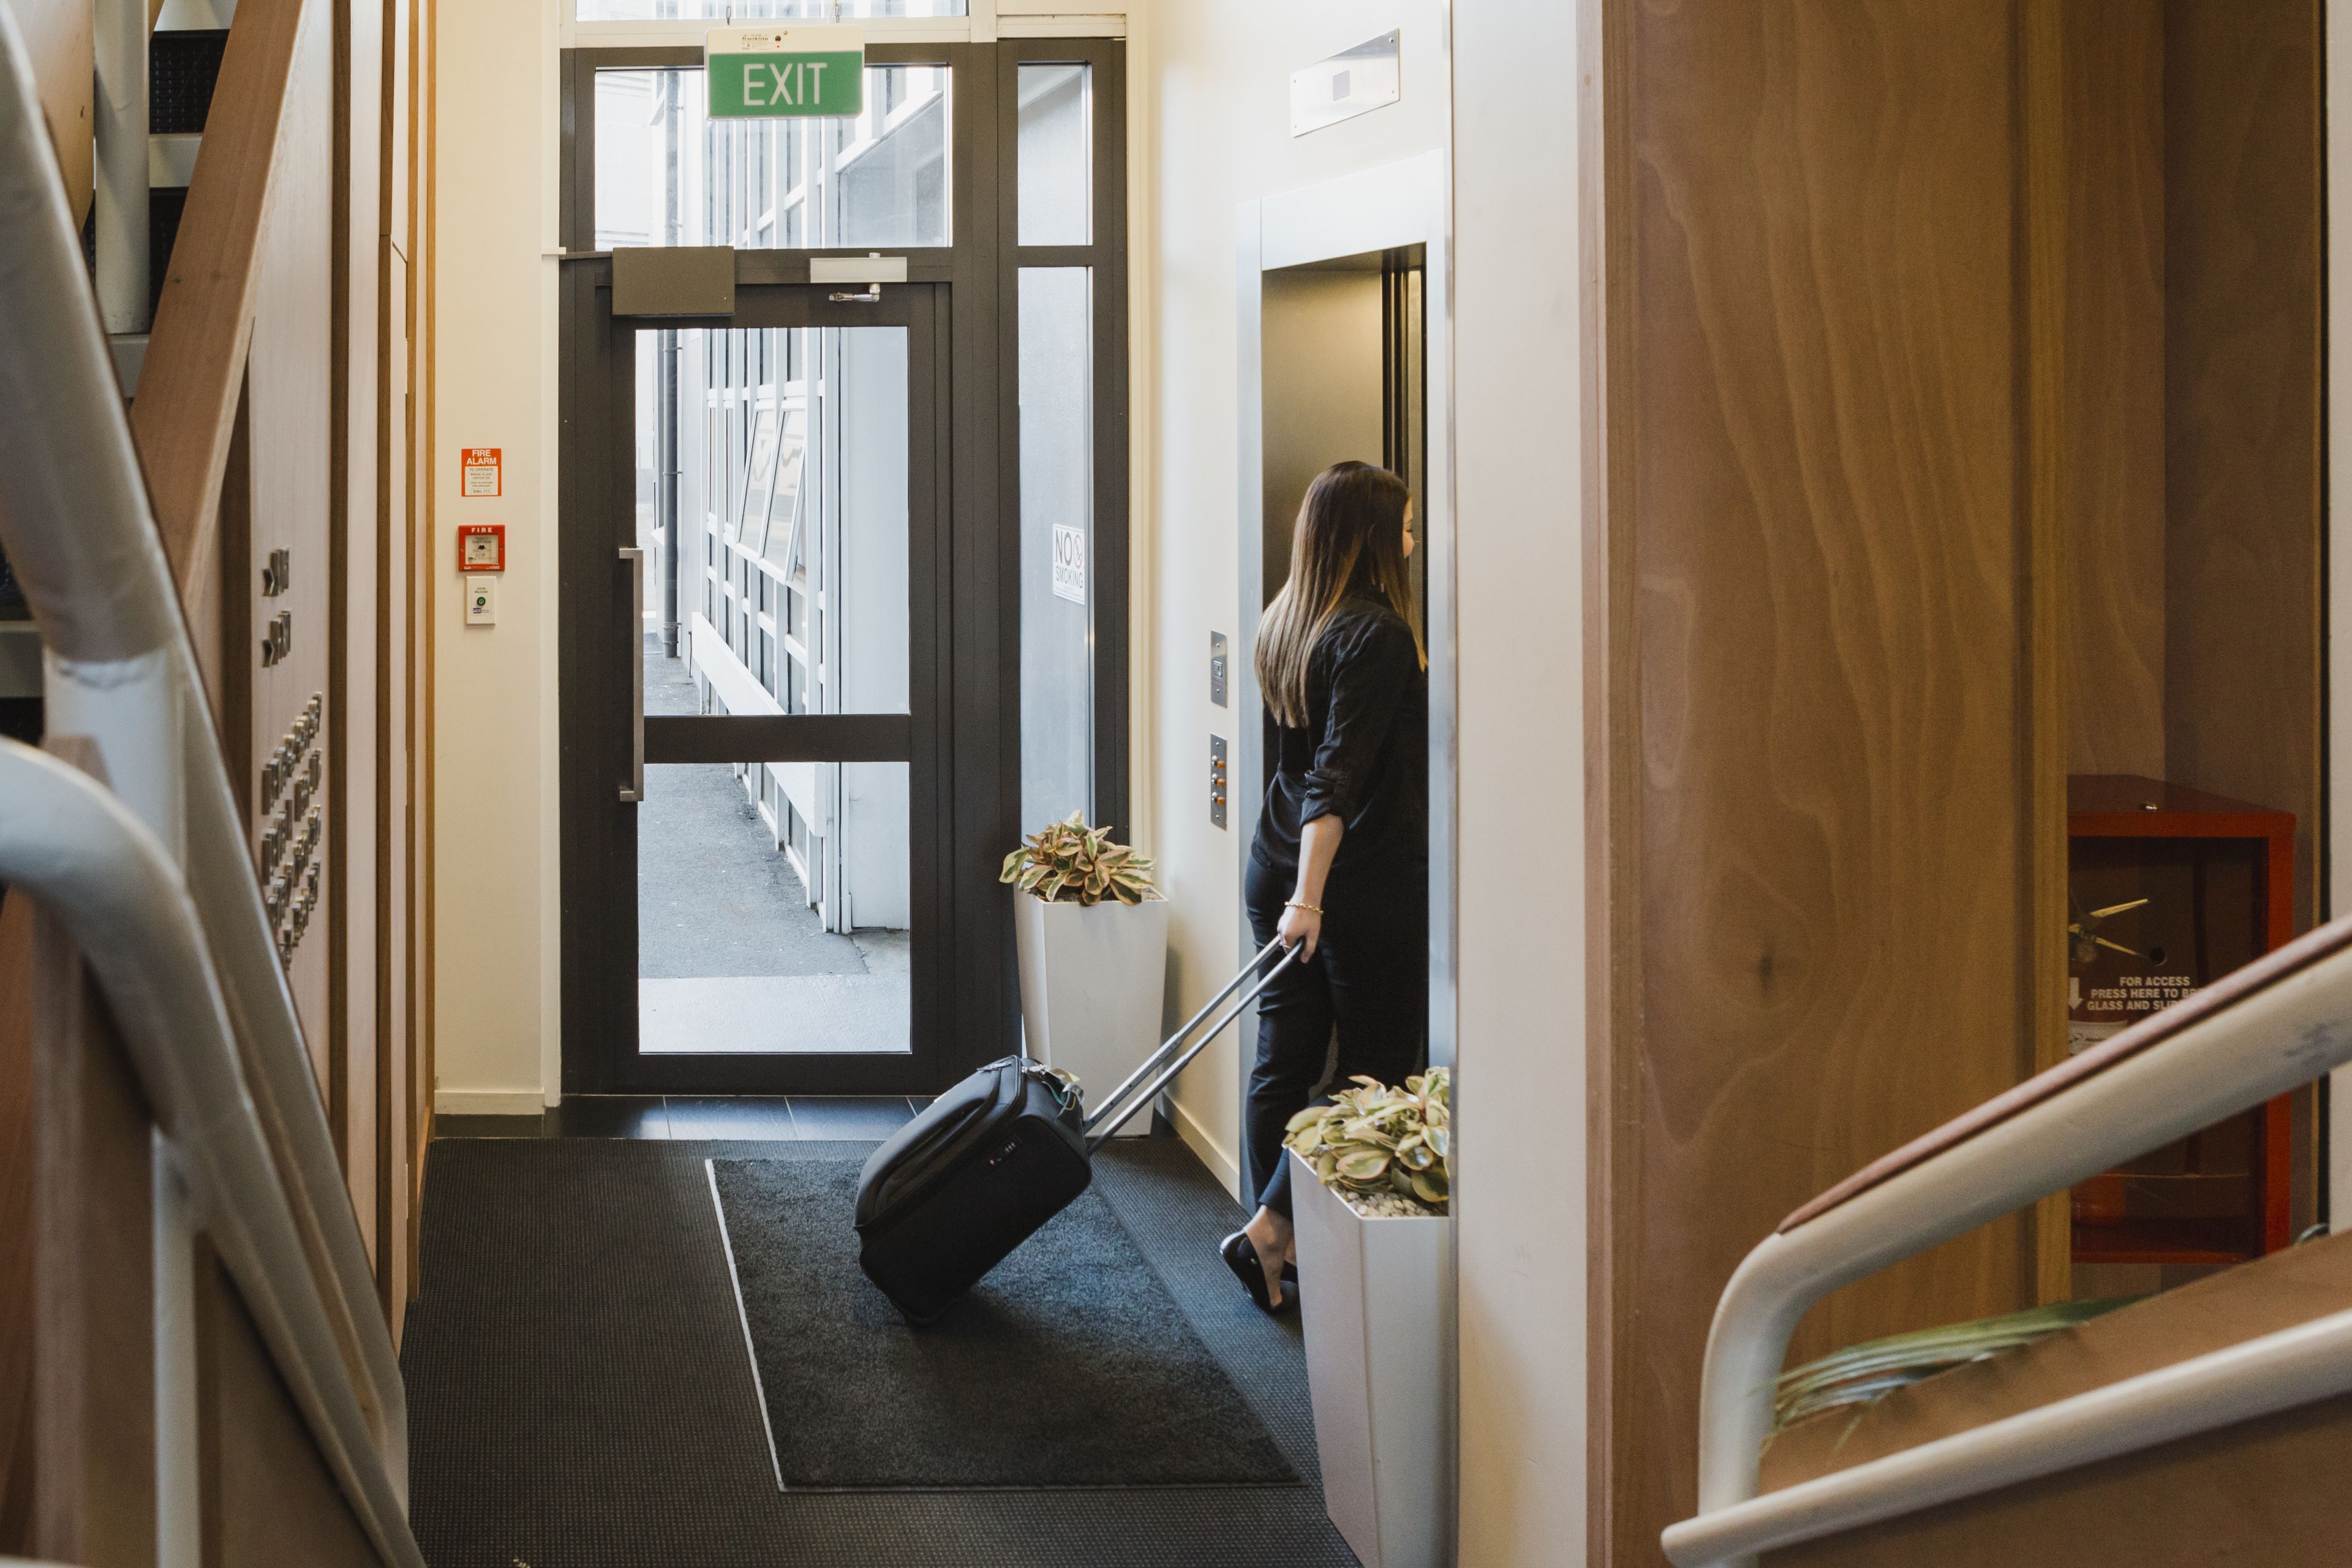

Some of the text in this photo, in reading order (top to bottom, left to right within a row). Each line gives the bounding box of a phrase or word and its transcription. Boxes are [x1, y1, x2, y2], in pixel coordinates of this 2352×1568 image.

[743, 62, 827, 106] EXIT
[1055, 529, 1072, 566] NO
[1055, 565, 1083, 589] SMOKING
[2119, 976, 2191, 987] FOR ACCESS
[2091, 989, 2127, 998] PRESS
[2130, 989, 2160, 998] HERE
[2163, 989, 2179, 998] TO
[2087, 1000, 2124, 1010] GLASS
[2126, 1000, 2150, 1009] AND
